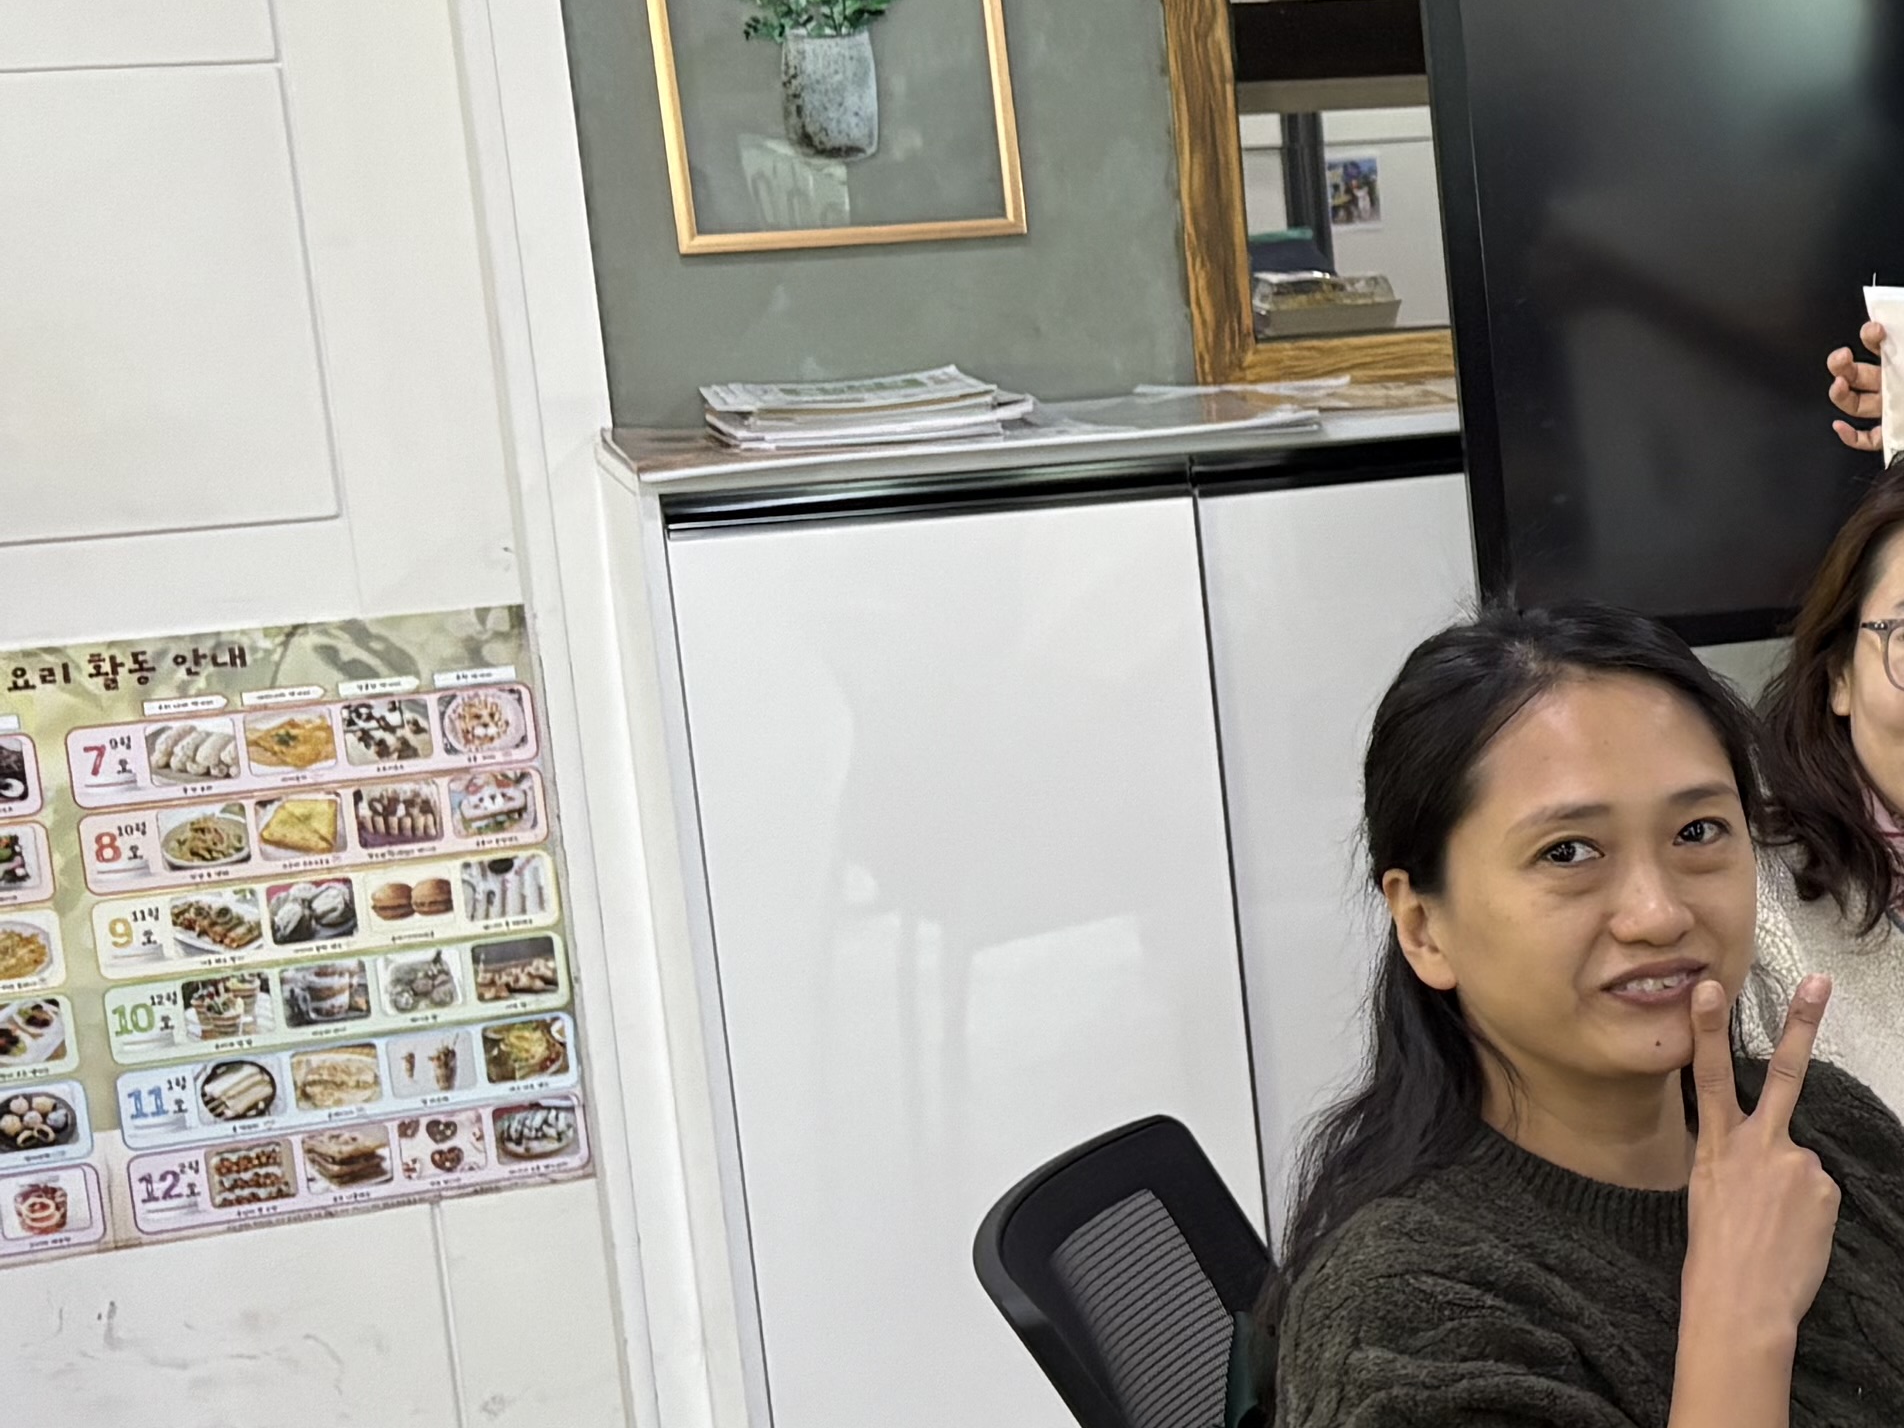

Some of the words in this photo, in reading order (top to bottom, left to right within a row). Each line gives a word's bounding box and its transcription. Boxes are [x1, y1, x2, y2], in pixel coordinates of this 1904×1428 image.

[7, 662, 71, 693] 요리
[87, 644, 156, 691] 활동
[172, 645, 248, 677] 안내
[83, 745, 107, 777] 7
[94, 832, 122, 864] 8
[108, 918, 133, 949] 9
[112, 1003, 156, 1038] 10
[127, 1085, 169, 1120] 11
[138, 1170, 184, 1205] 12
